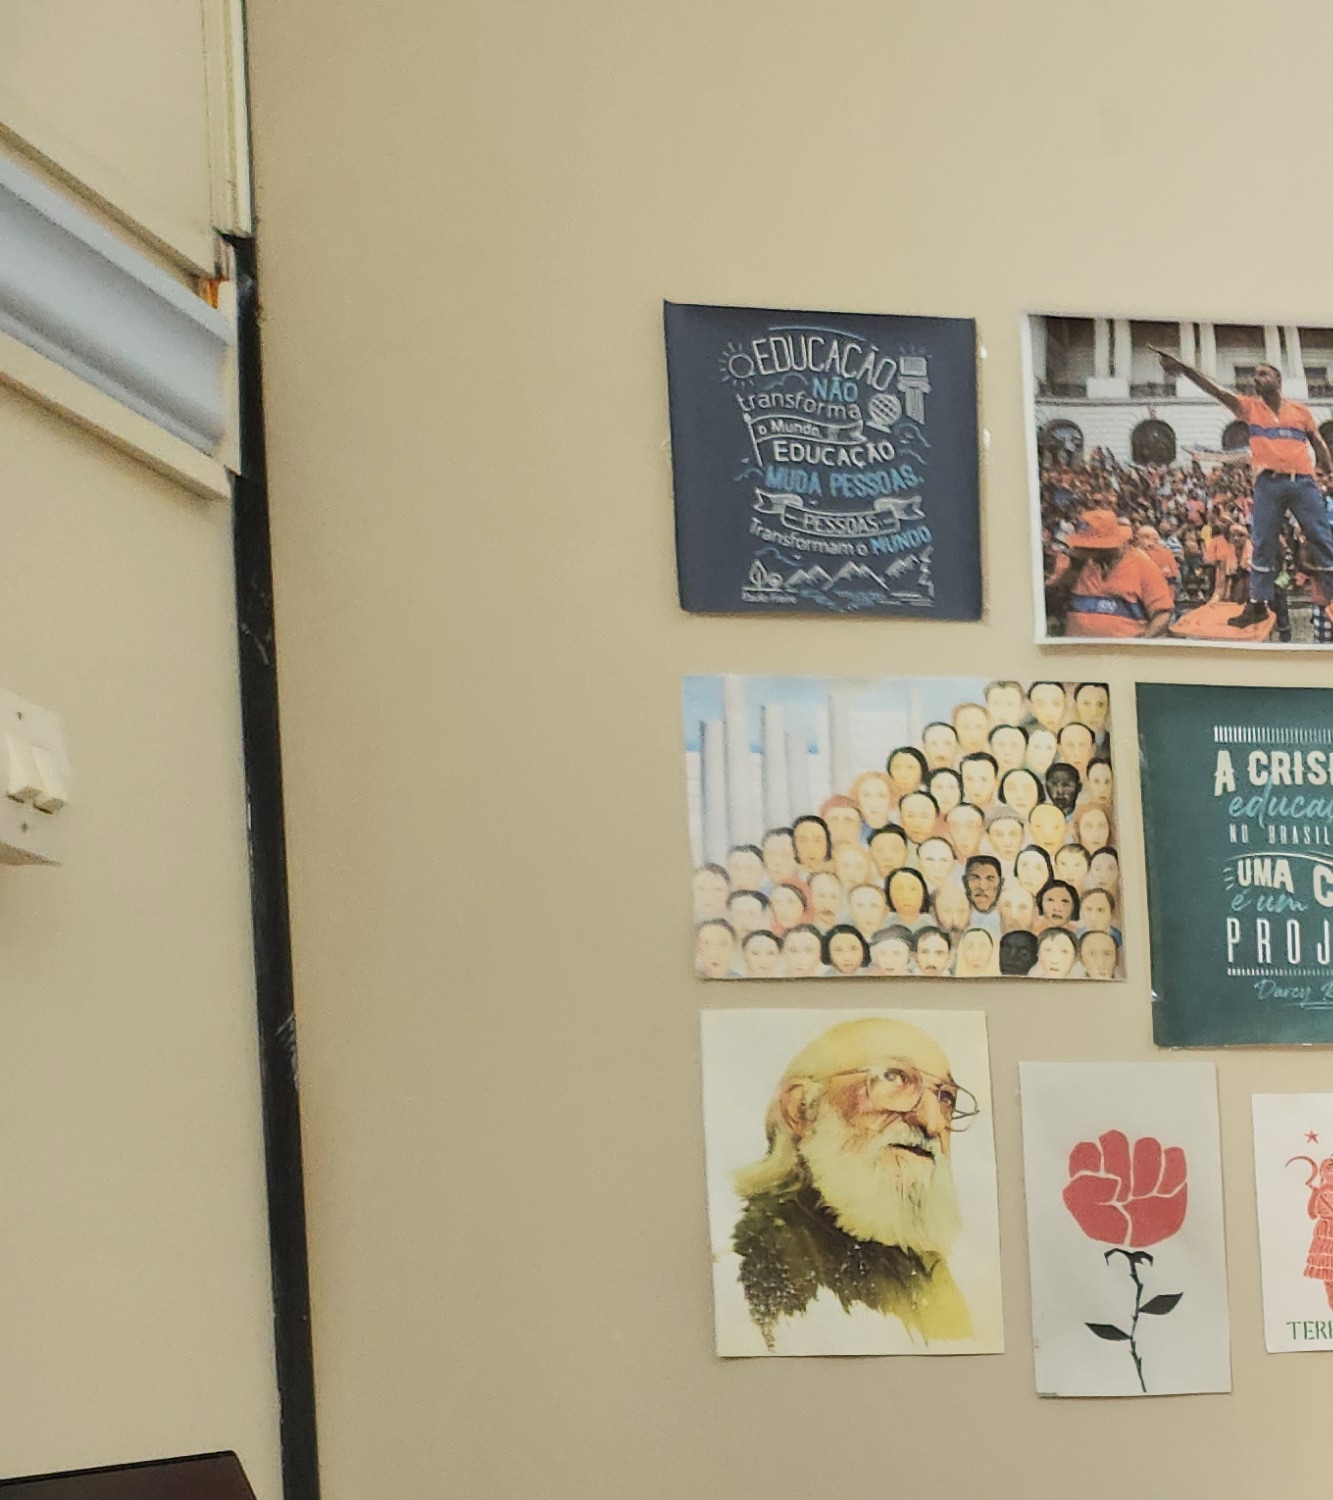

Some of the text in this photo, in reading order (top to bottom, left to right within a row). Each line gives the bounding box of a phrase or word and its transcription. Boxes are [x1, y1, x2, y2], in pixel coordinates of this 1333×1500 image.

[752, 334, 897, 391] EDUCAÇÃO
[812, 376, 858, 402] NÃO
[736, 390, 863, 420] transforma
[772, 439, 895, 470] EDUCAÇÃO
[764, 464, 822, 496] MUDA
[749, 518, 933, 557] Transformam o MUNDO
[1214, 750, 1236, 796] A
[1229, 823, 1248, 844] NO
[1268, 825, 1330, 845] BRASIL
[1237, 858, 1295, 893] UMA
[1230, 890, 1308, 913] é um
[1253, 978, 1312, 1001] Darcy
